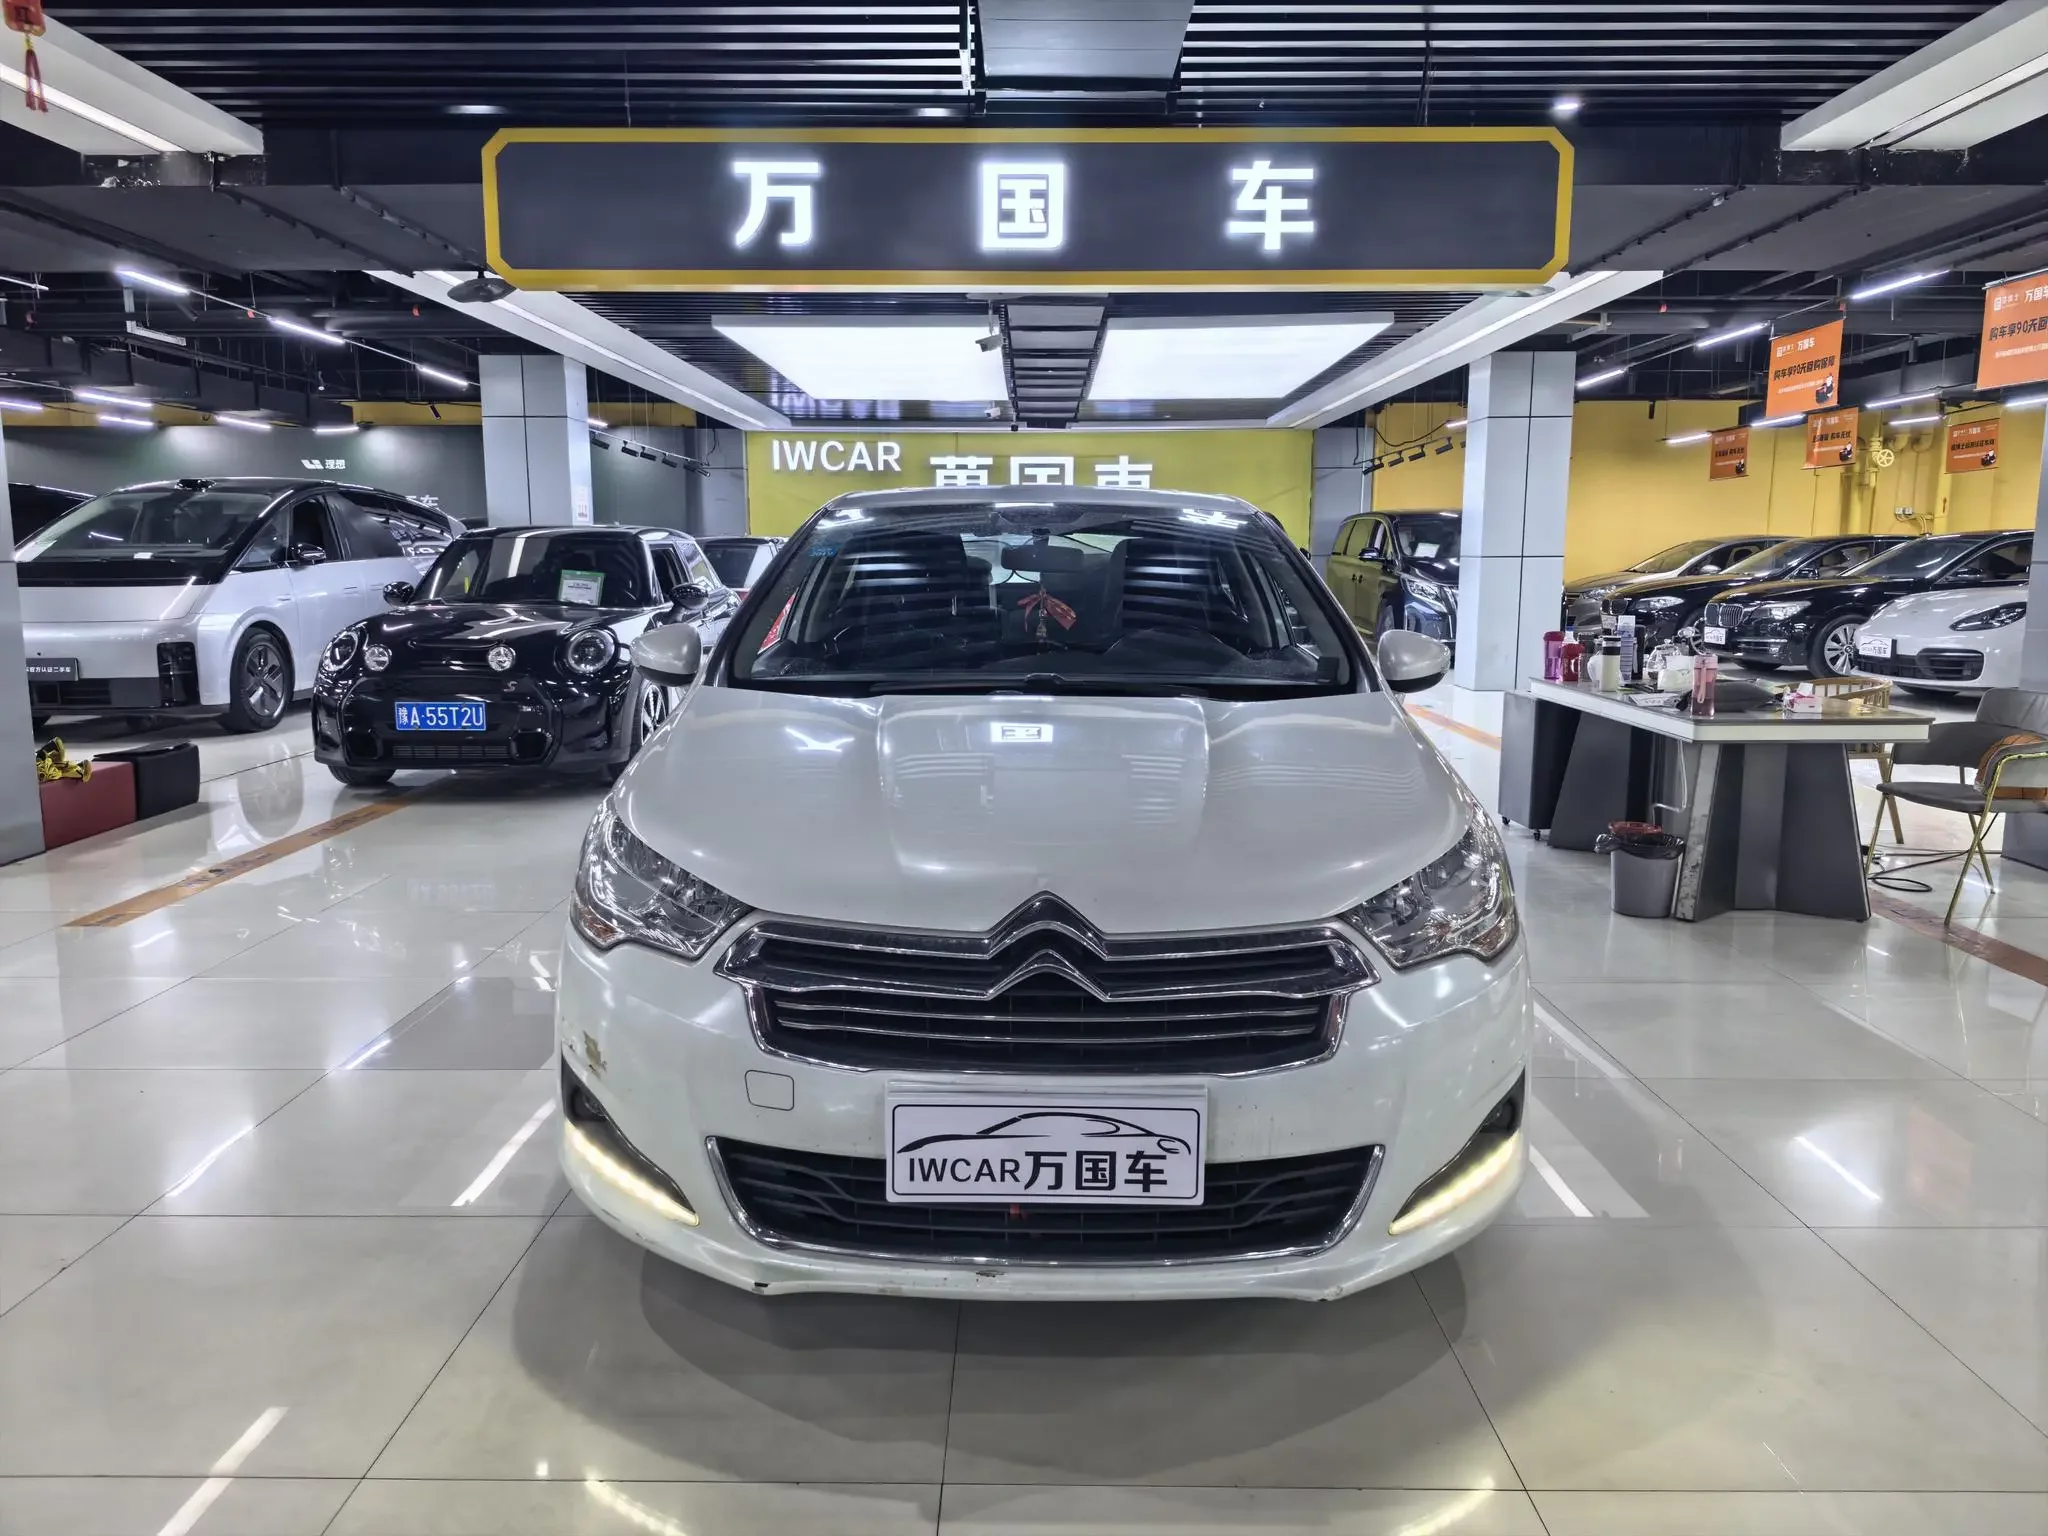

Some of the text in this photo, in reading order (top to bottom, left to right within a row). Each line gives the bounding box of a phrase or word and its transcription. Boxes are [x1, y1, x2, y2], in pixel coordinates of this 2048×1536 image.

[731, 159, 1316, 251] 万国车
[324, 459, 347, 470] 理想
[771, 439, 902, 472] IWCAR
